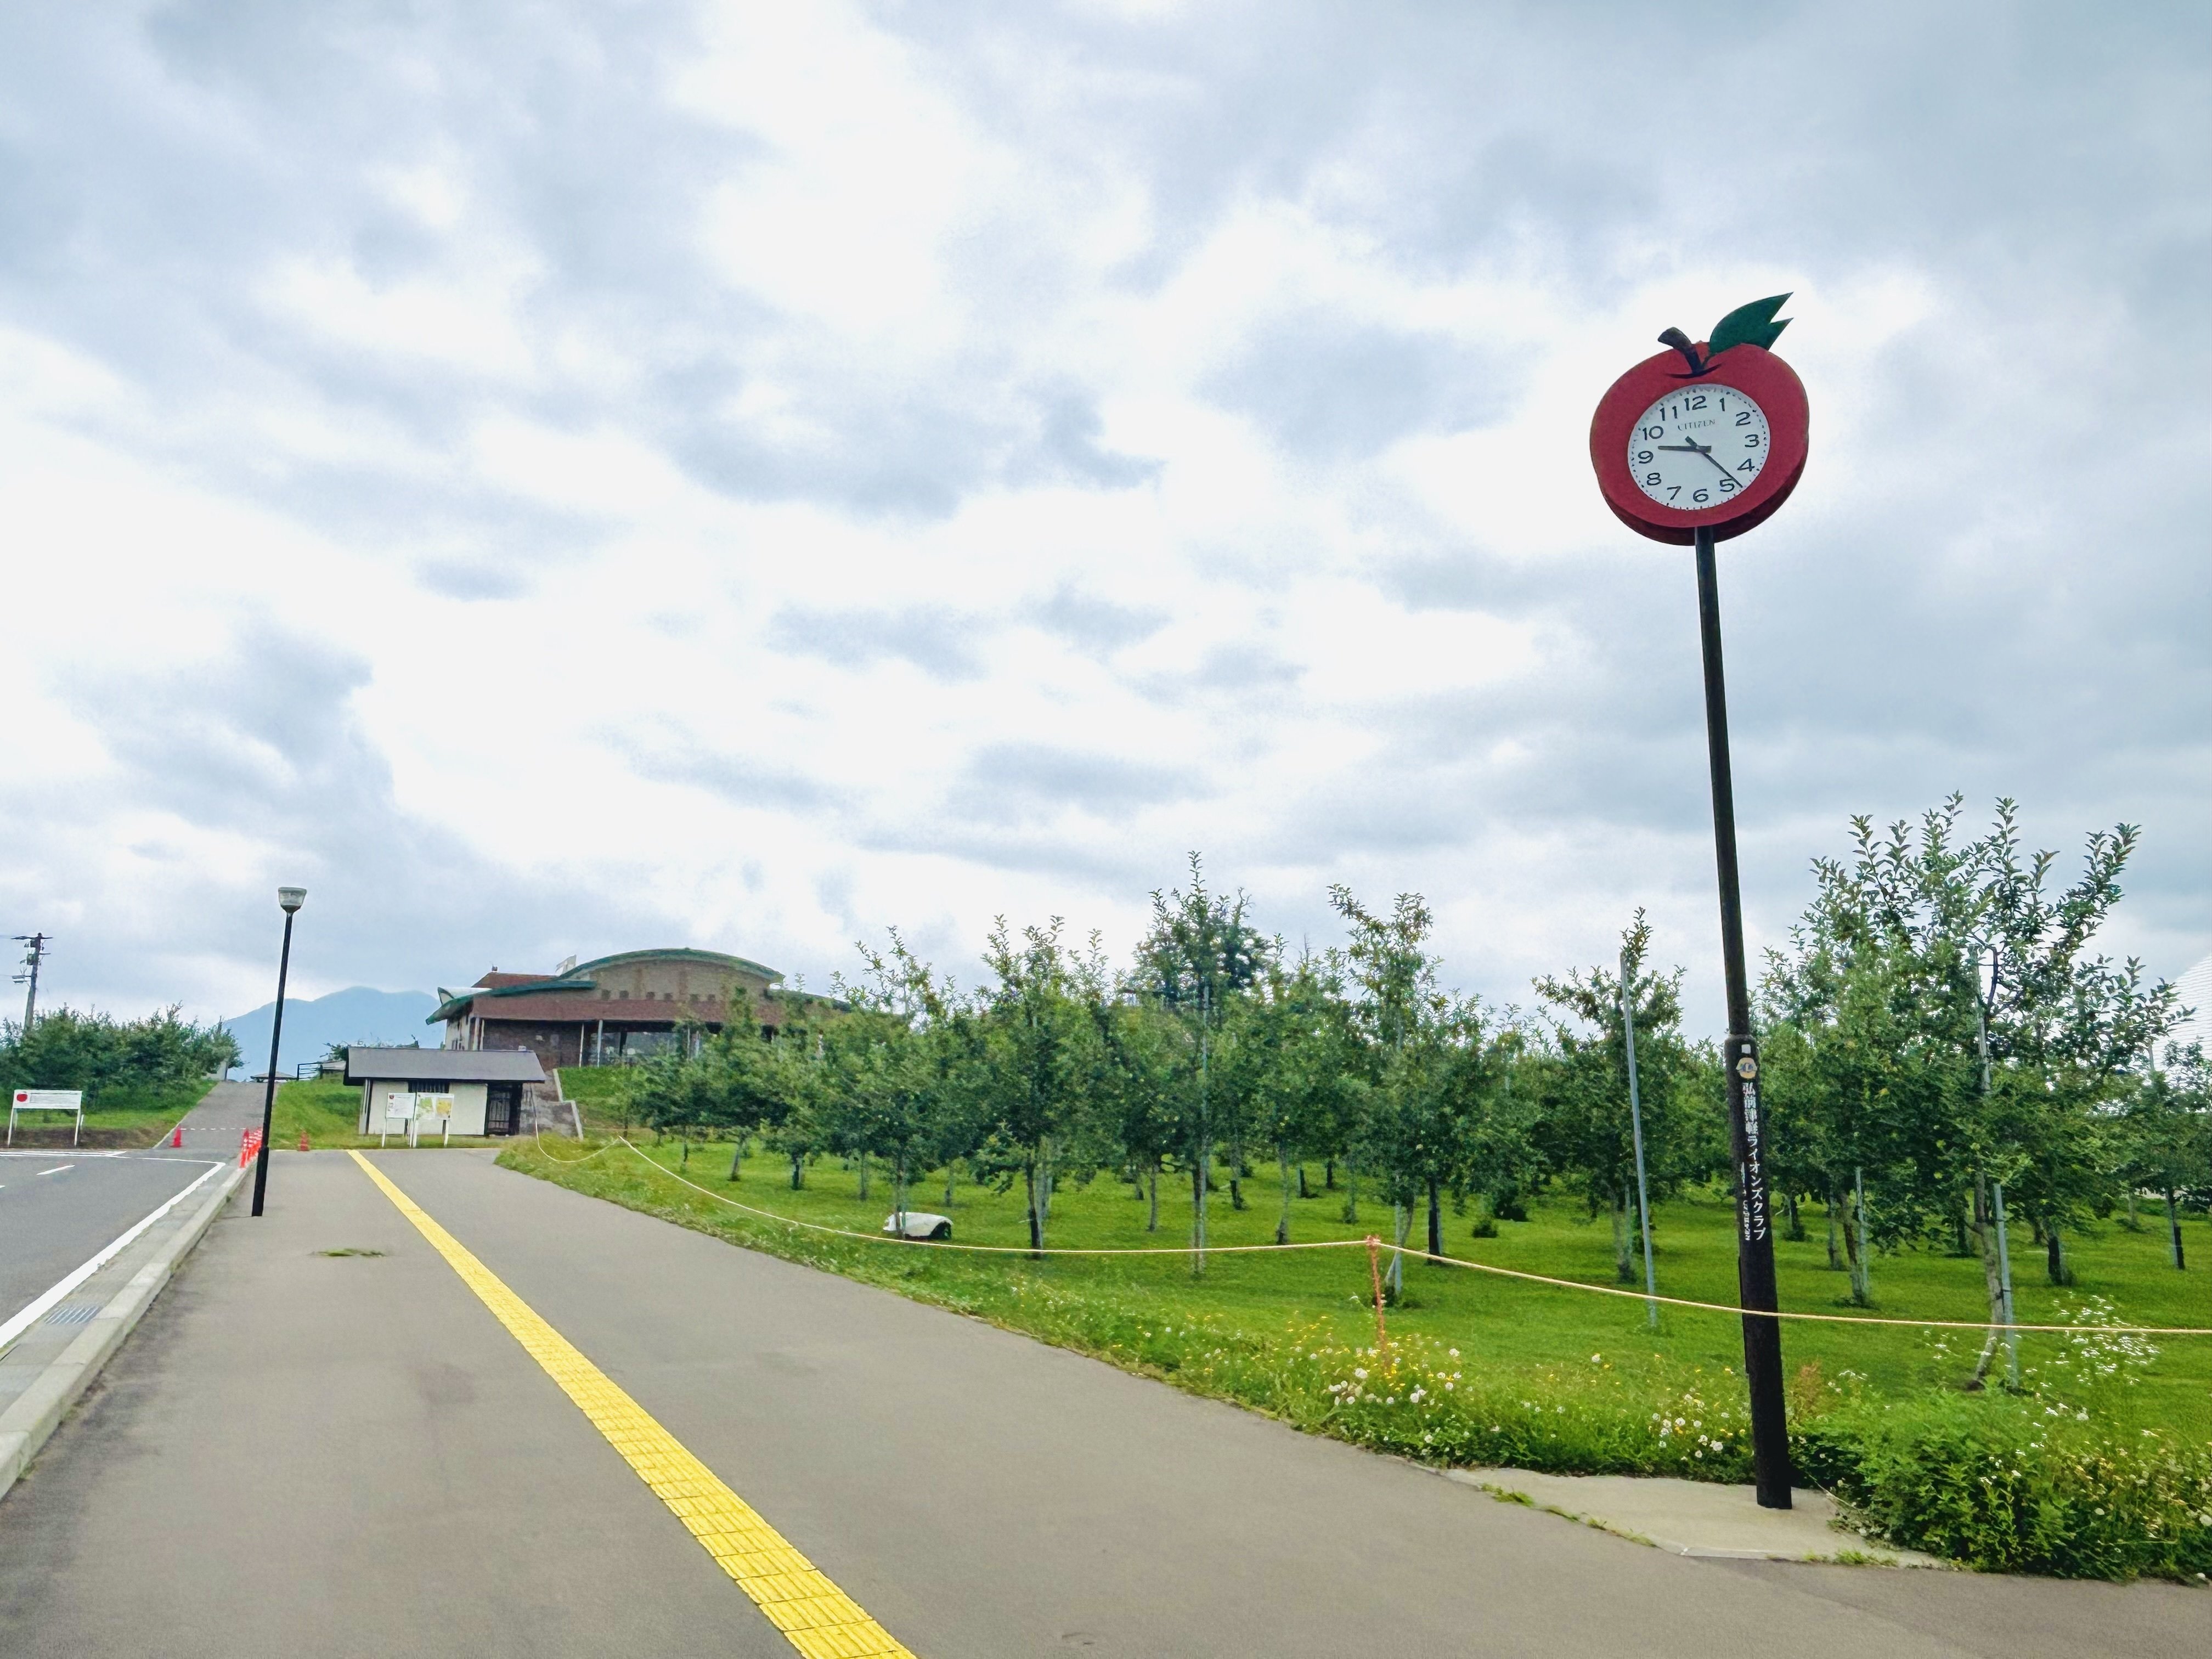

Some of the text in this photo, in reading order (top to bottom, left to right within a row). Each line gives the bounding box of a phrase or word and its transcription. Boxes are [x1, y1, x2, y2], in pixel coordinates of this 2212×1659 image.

[1684, 396, 1707, 411] 12
[1719, 398, 1725, 411] 1
[1660, 406, 1678, 421] 11
[1736, 411, 1751, 426] 2
[1678, 419, 1716, 431] CITIZEN
[1643, 426, 1664, 441] 10
[1745, 434, 1759, 447] 3
[1638, 451, 1654, 464] 9
[1737, 459, 1755, 471] 4
[1646, 472, 1661, 486] 8
[1719, 479, 1735, 492] 5
[1667, 486, 1681, 500] 7
[1693, 489, 1708, 502] 6
